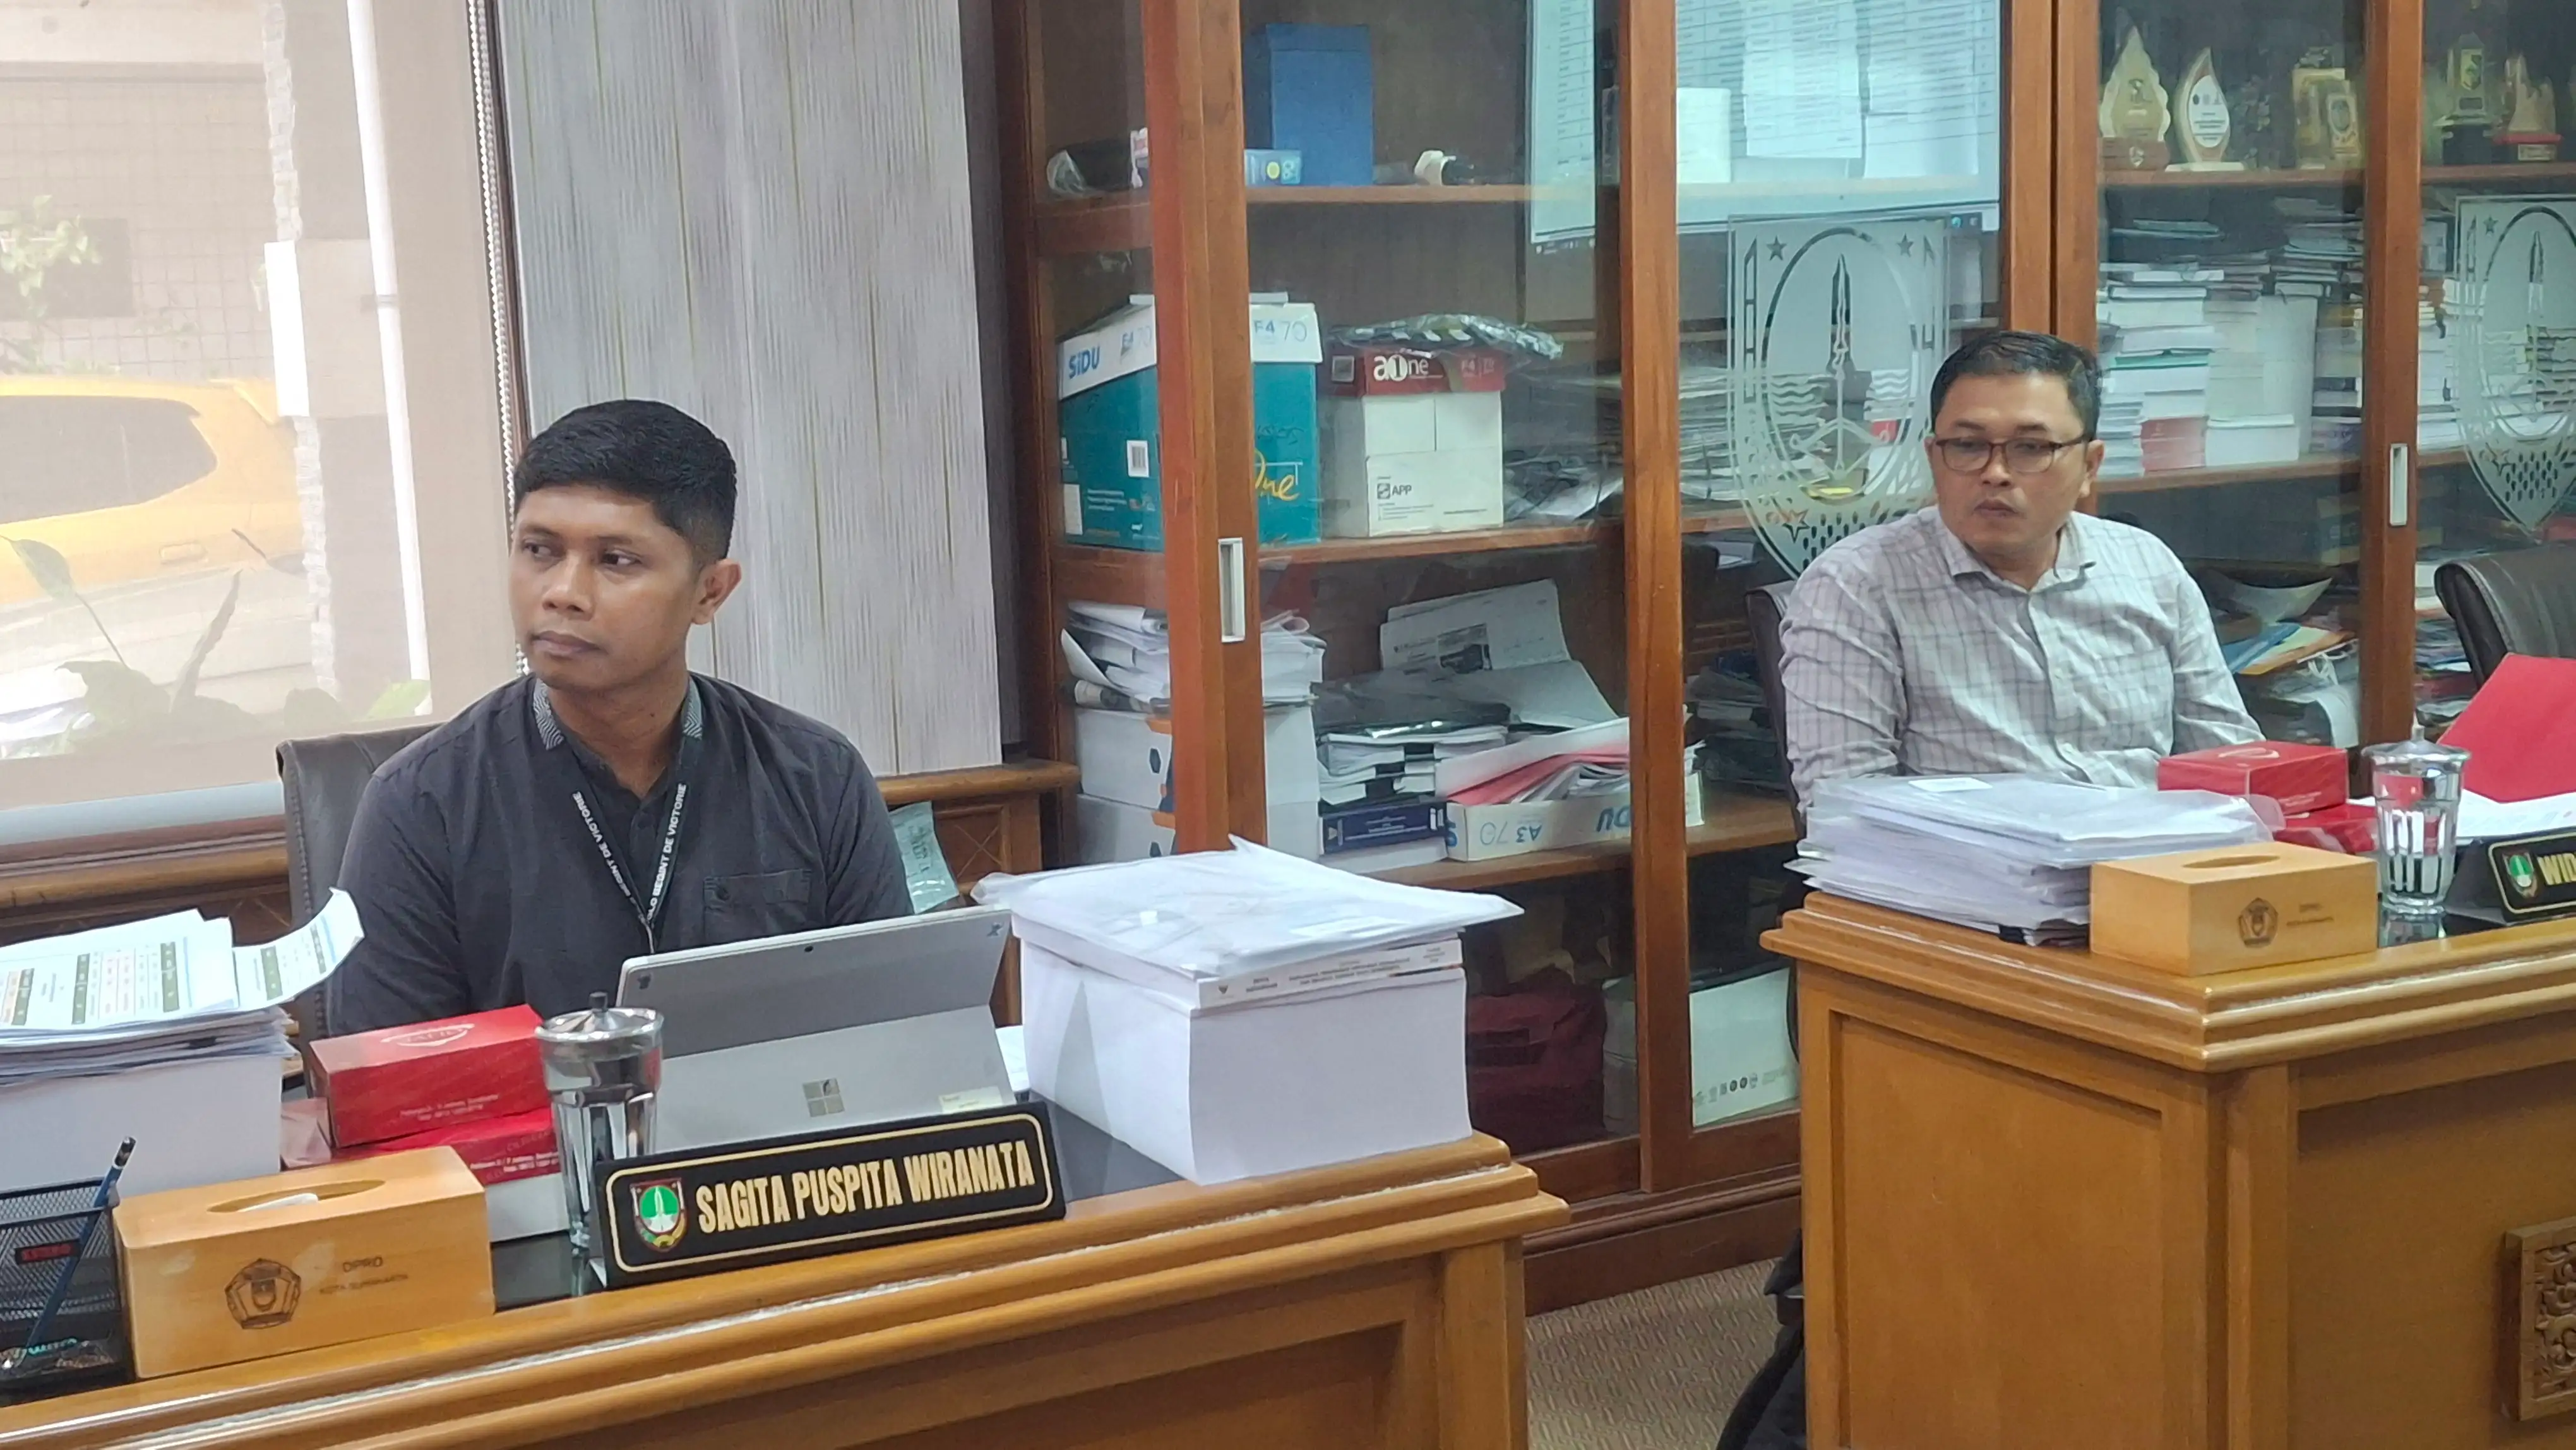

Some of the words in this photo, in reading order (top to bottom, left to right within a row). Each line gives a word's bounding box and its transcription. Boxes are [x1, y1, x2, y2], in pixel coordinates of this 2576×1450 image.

[1253, 319, 1275, 335] F4
[1280, 320, 1308, 342] 70
[1392, 484, 1412, 496] APP
[1479, 821, 1508, 845] 70
[1515, 824, 1542, 843] A3
[2536, 853, 2576, 885] WID
[695, 1175, 792, 1234] SAGITA
[791, 1159, 903, 1220] PUSPITA
[903, 1140, 1035, 1202] WIRANATA
